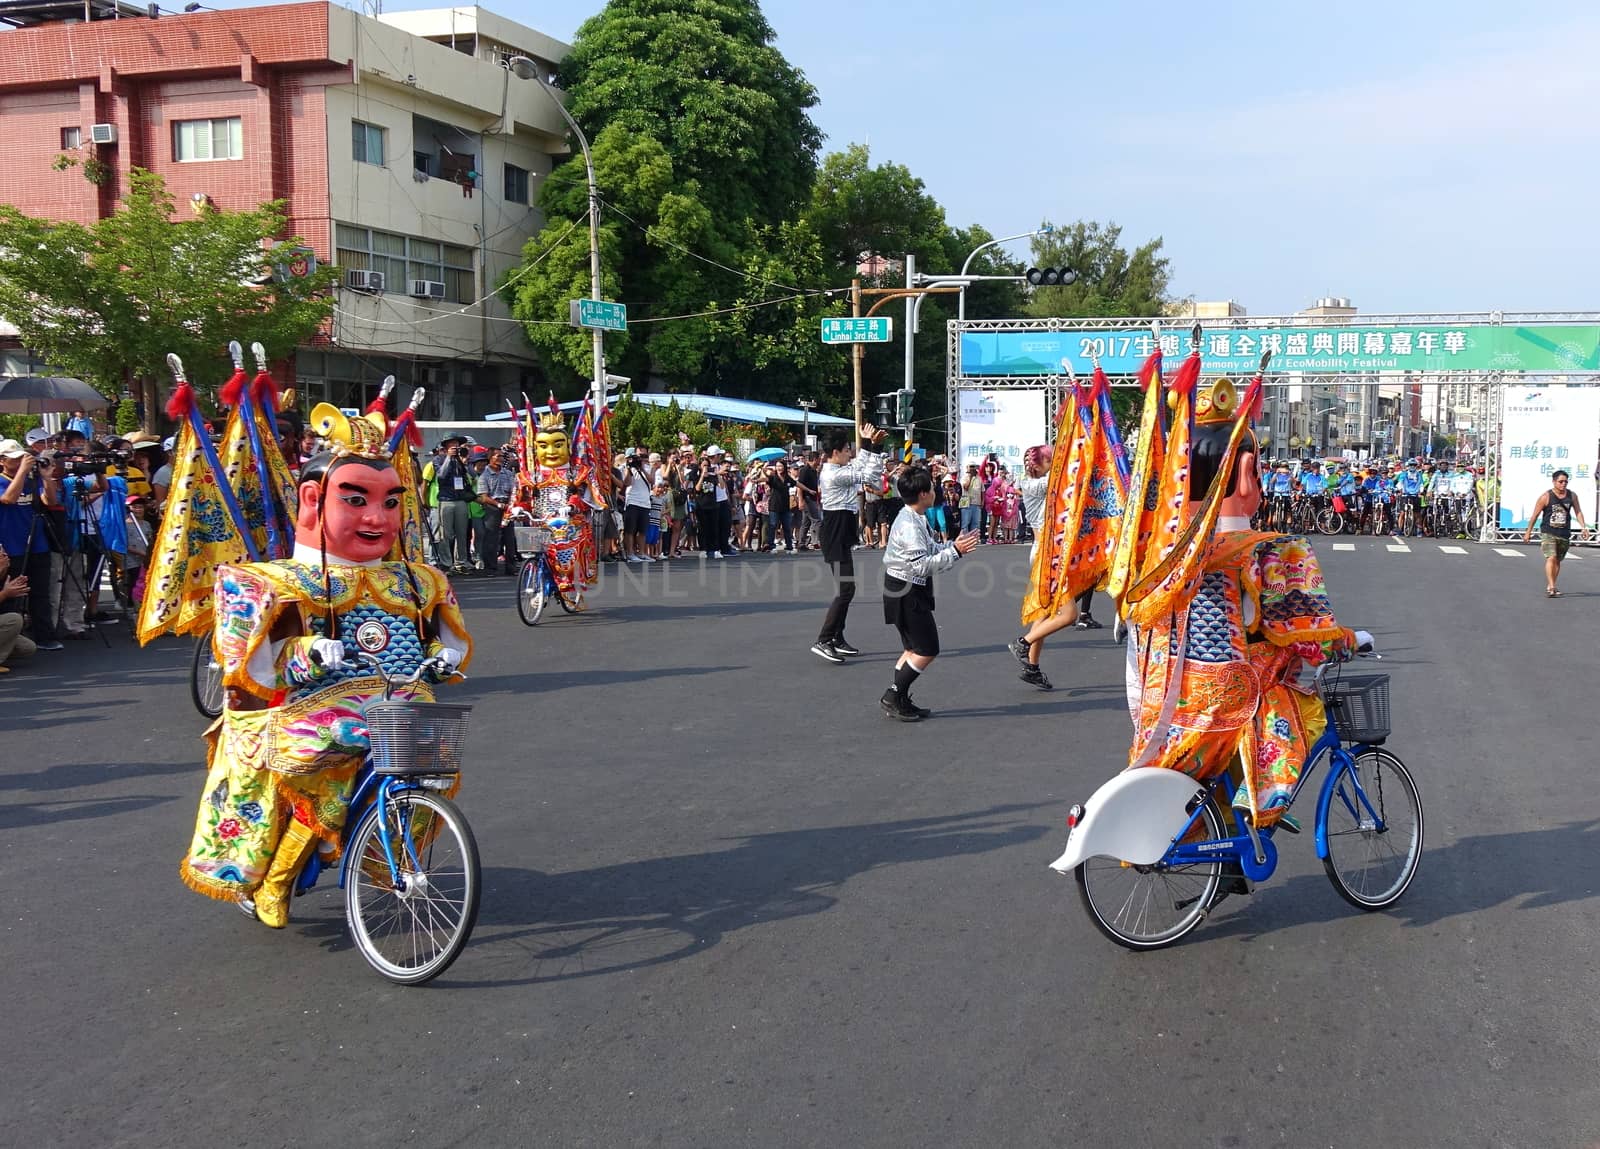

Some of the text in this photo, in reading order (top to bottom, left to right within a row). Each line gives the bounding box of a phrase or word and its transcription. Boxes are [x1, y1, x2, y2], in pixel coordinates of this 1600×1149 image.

[831, 331, 879, 340] Linhai 3rd Rd.
[1201, 357, 1397, 370] remony of 17 EcoMobility Festival
